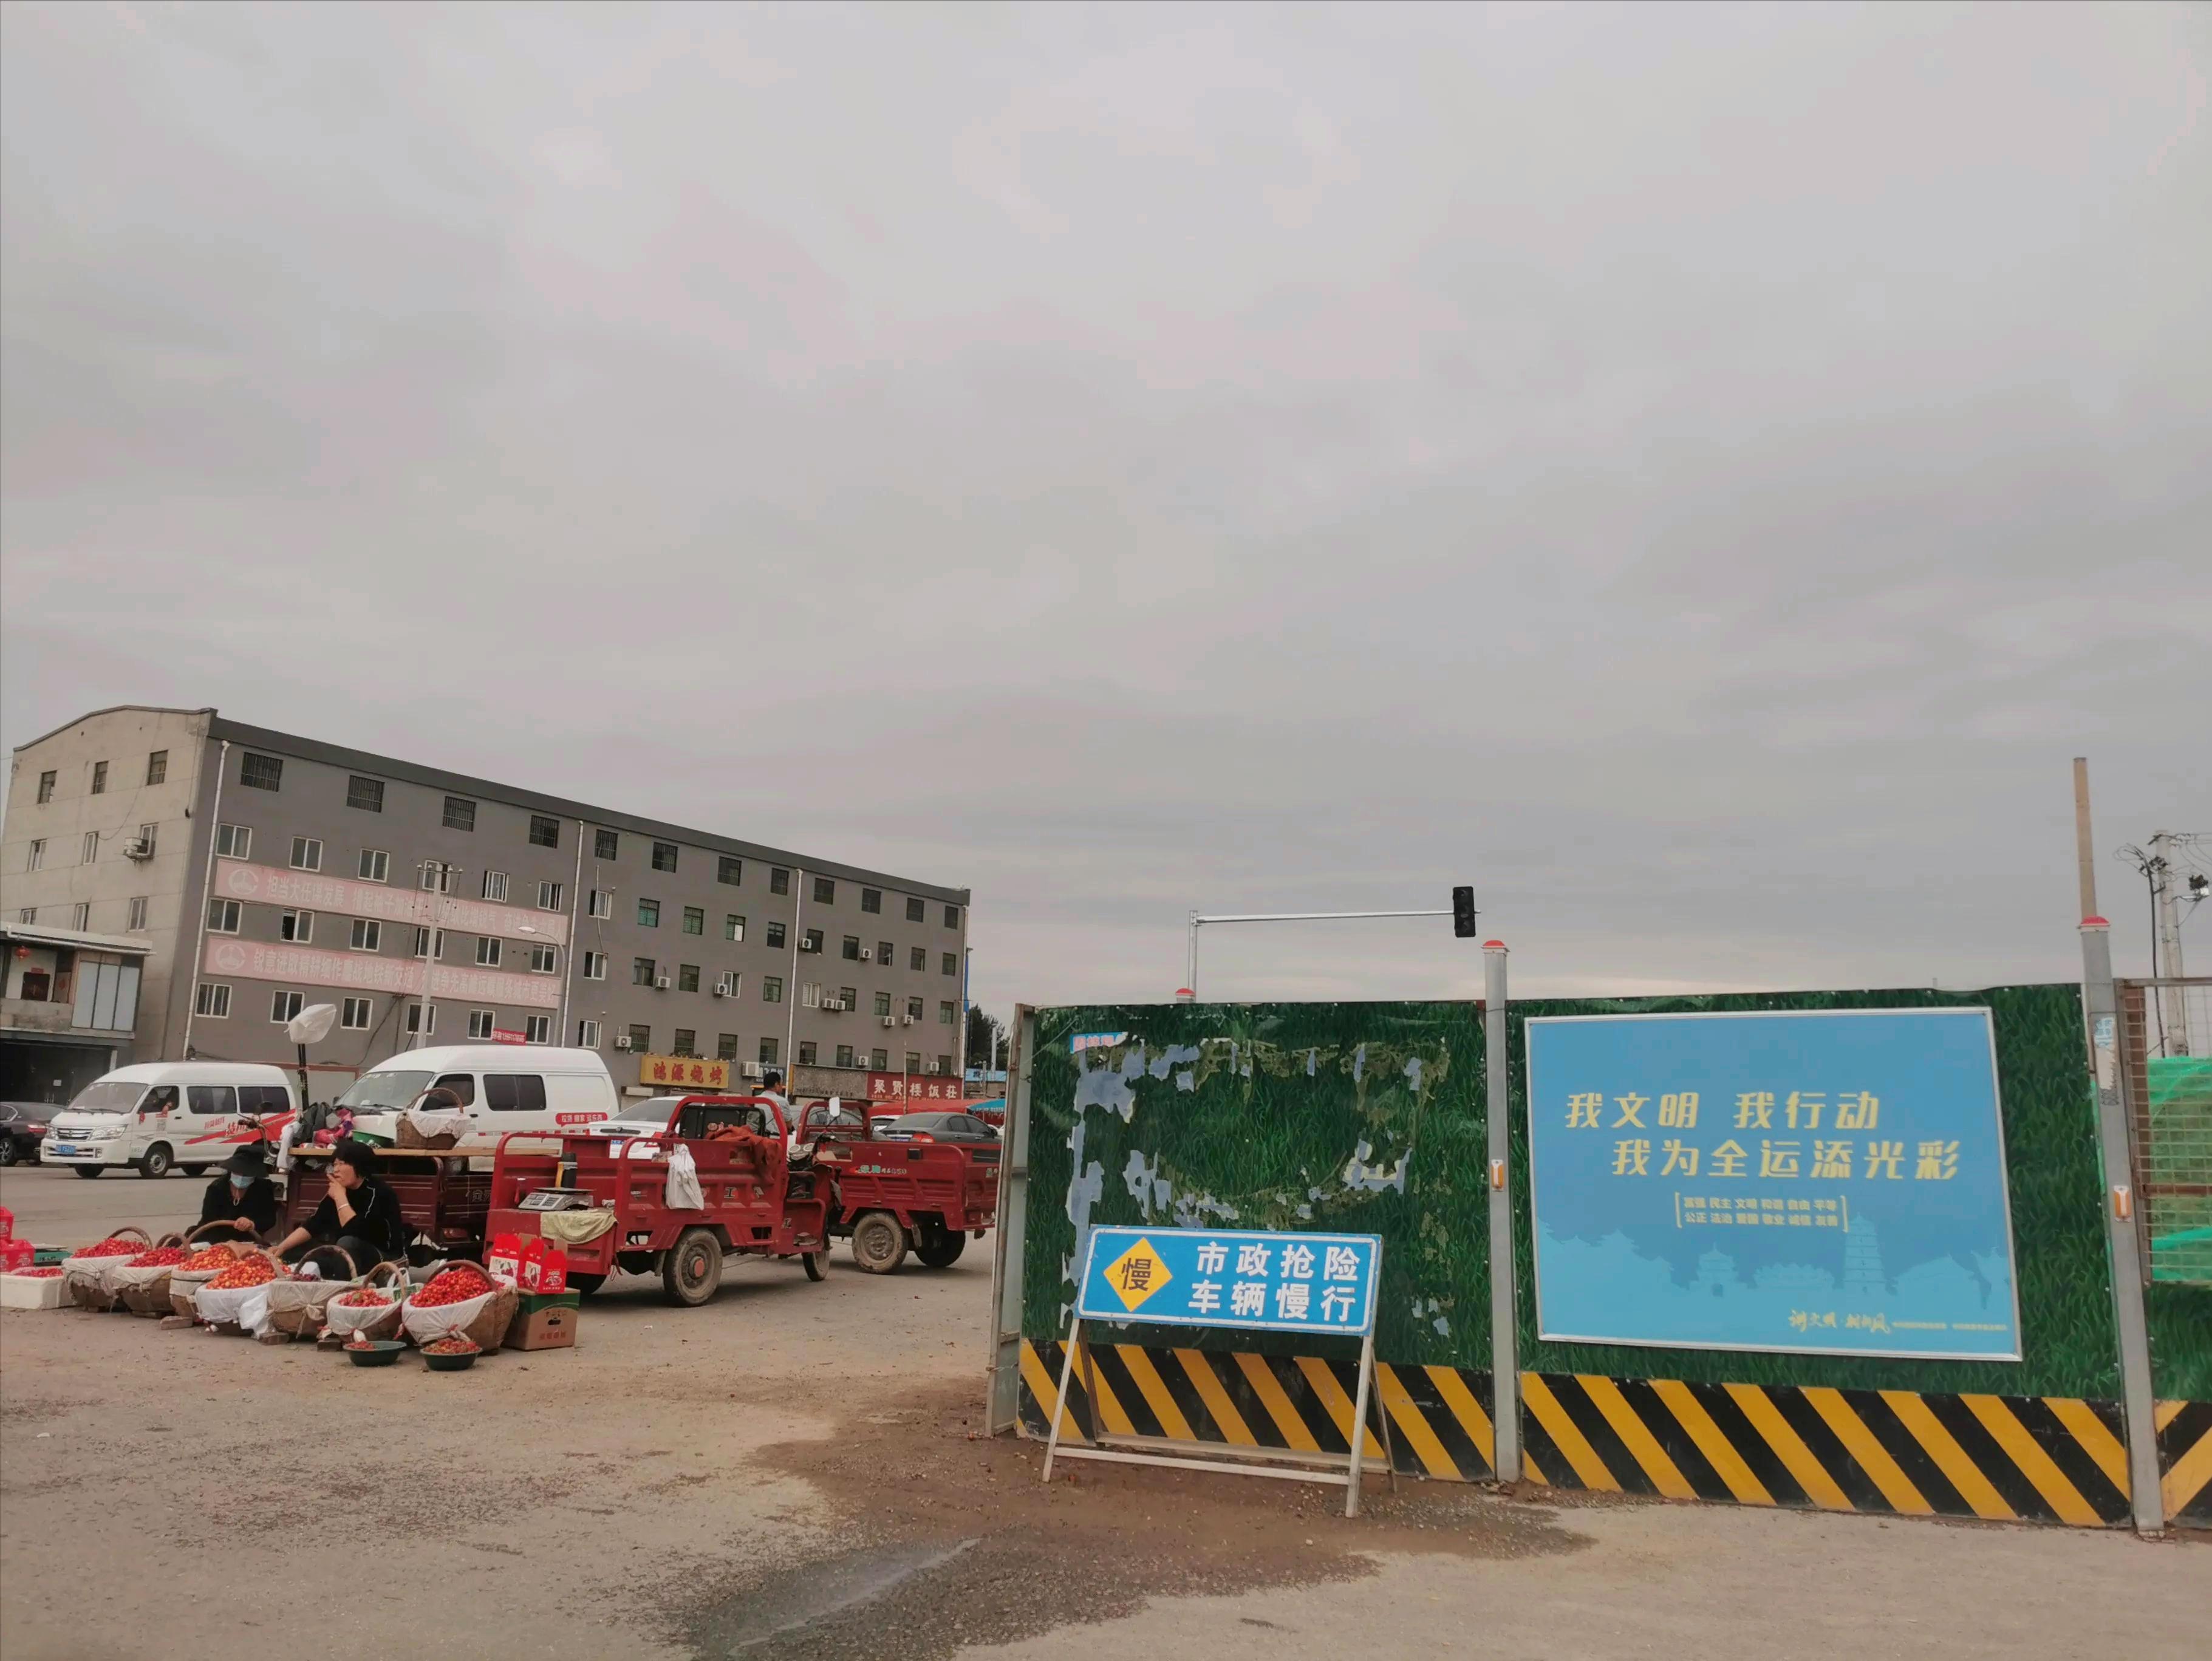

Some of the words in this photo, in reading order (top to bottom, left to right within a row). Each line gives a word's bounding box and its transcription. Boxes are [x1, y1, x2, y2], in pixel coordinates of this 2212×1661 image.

[1565, 1092, 1700, 1129] 我文明
[1733, 1091, 1880, 1130] 我行动
[1611, 1139, 1961, 1180] 我为全运添光彩
[1122, 1257, 1153, 1292] 慢
[1197, 1241, 1360, 1281] 市政抢险
[1188, 1280, 1356, 1322] 车辆慢行
